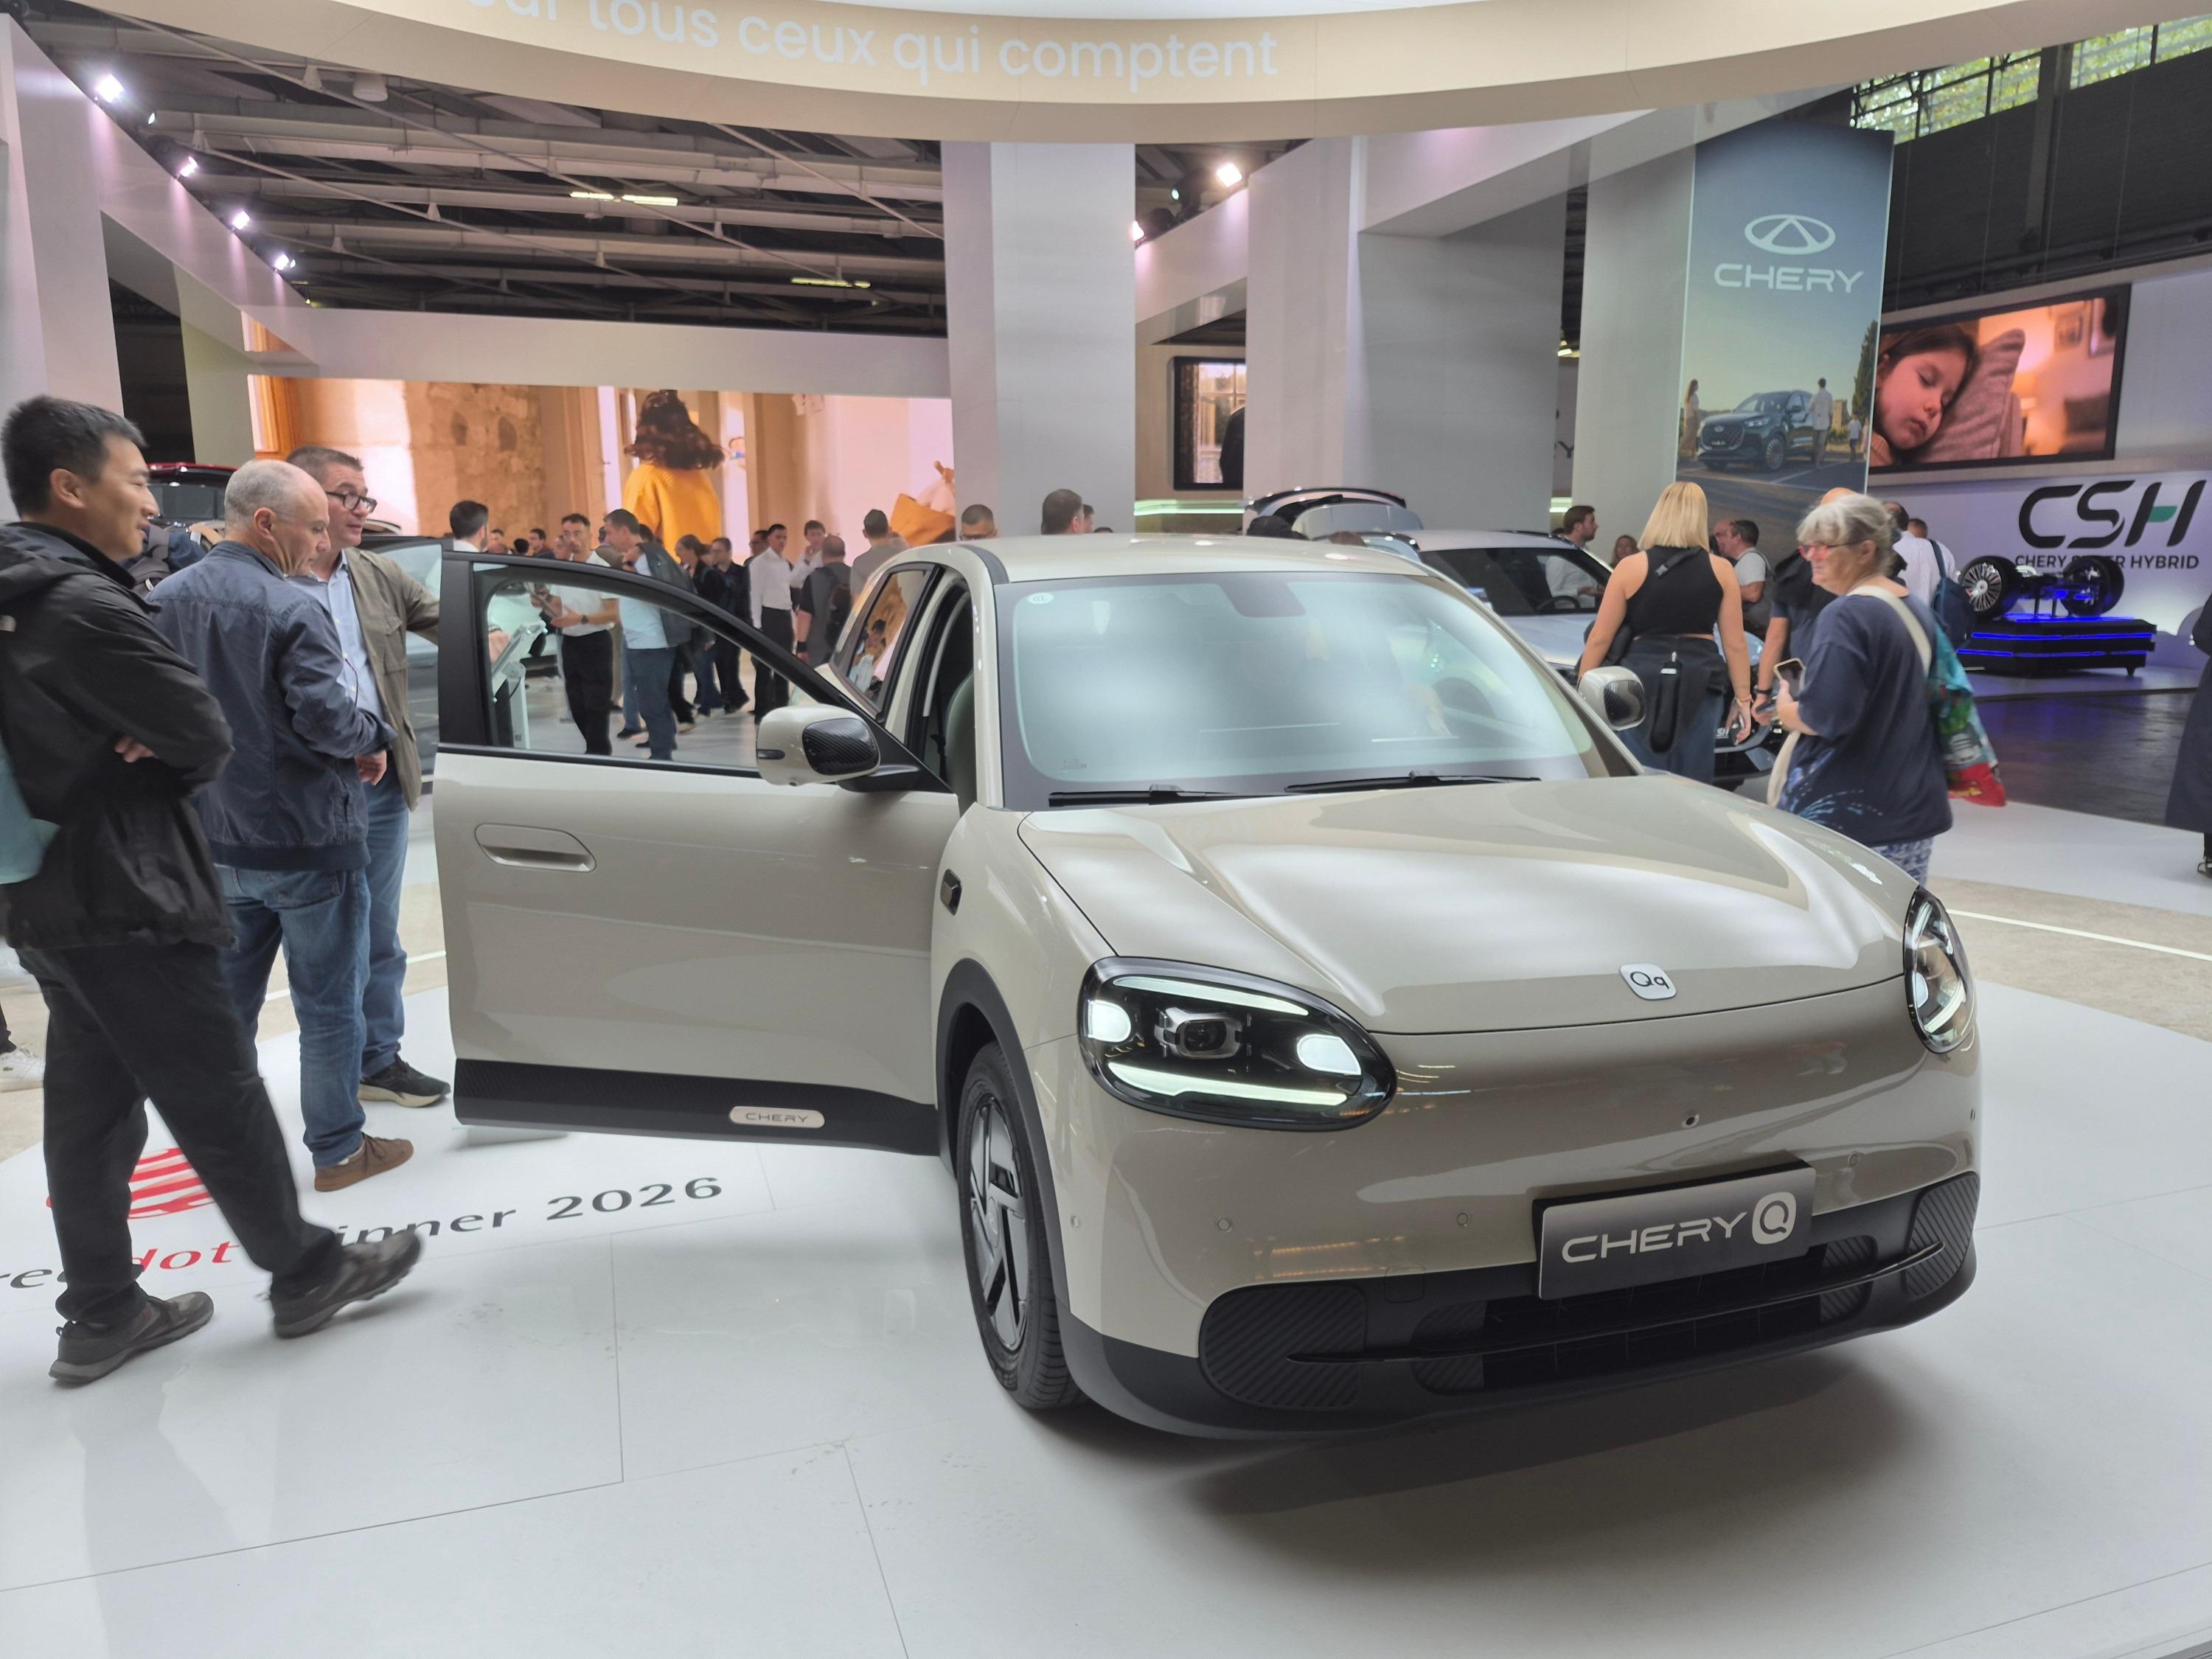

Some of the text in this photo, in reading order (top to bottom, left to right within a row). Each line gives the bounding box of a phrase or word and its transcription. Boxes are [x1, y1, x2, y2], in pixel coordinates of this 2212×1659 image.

[737, 15, 876, 66] ceux
[892, 24, 981, 87] qui
[998, 31, 1279, 94] comptent
[1714, 262, 1865, 293] CHERY
[2018, 479, 2208, 549] CSH
[2014, 554, 2067, 568] CHERY
[2129, 554, 2199, 569] HYBRID
[745, 1112, 809, 1123] CHERY
[336, 1208, 517, 1246] inner
[546, 1177, 722, 1221] 2026
[1561, 1197, 1791, 1264] CHERY Q
